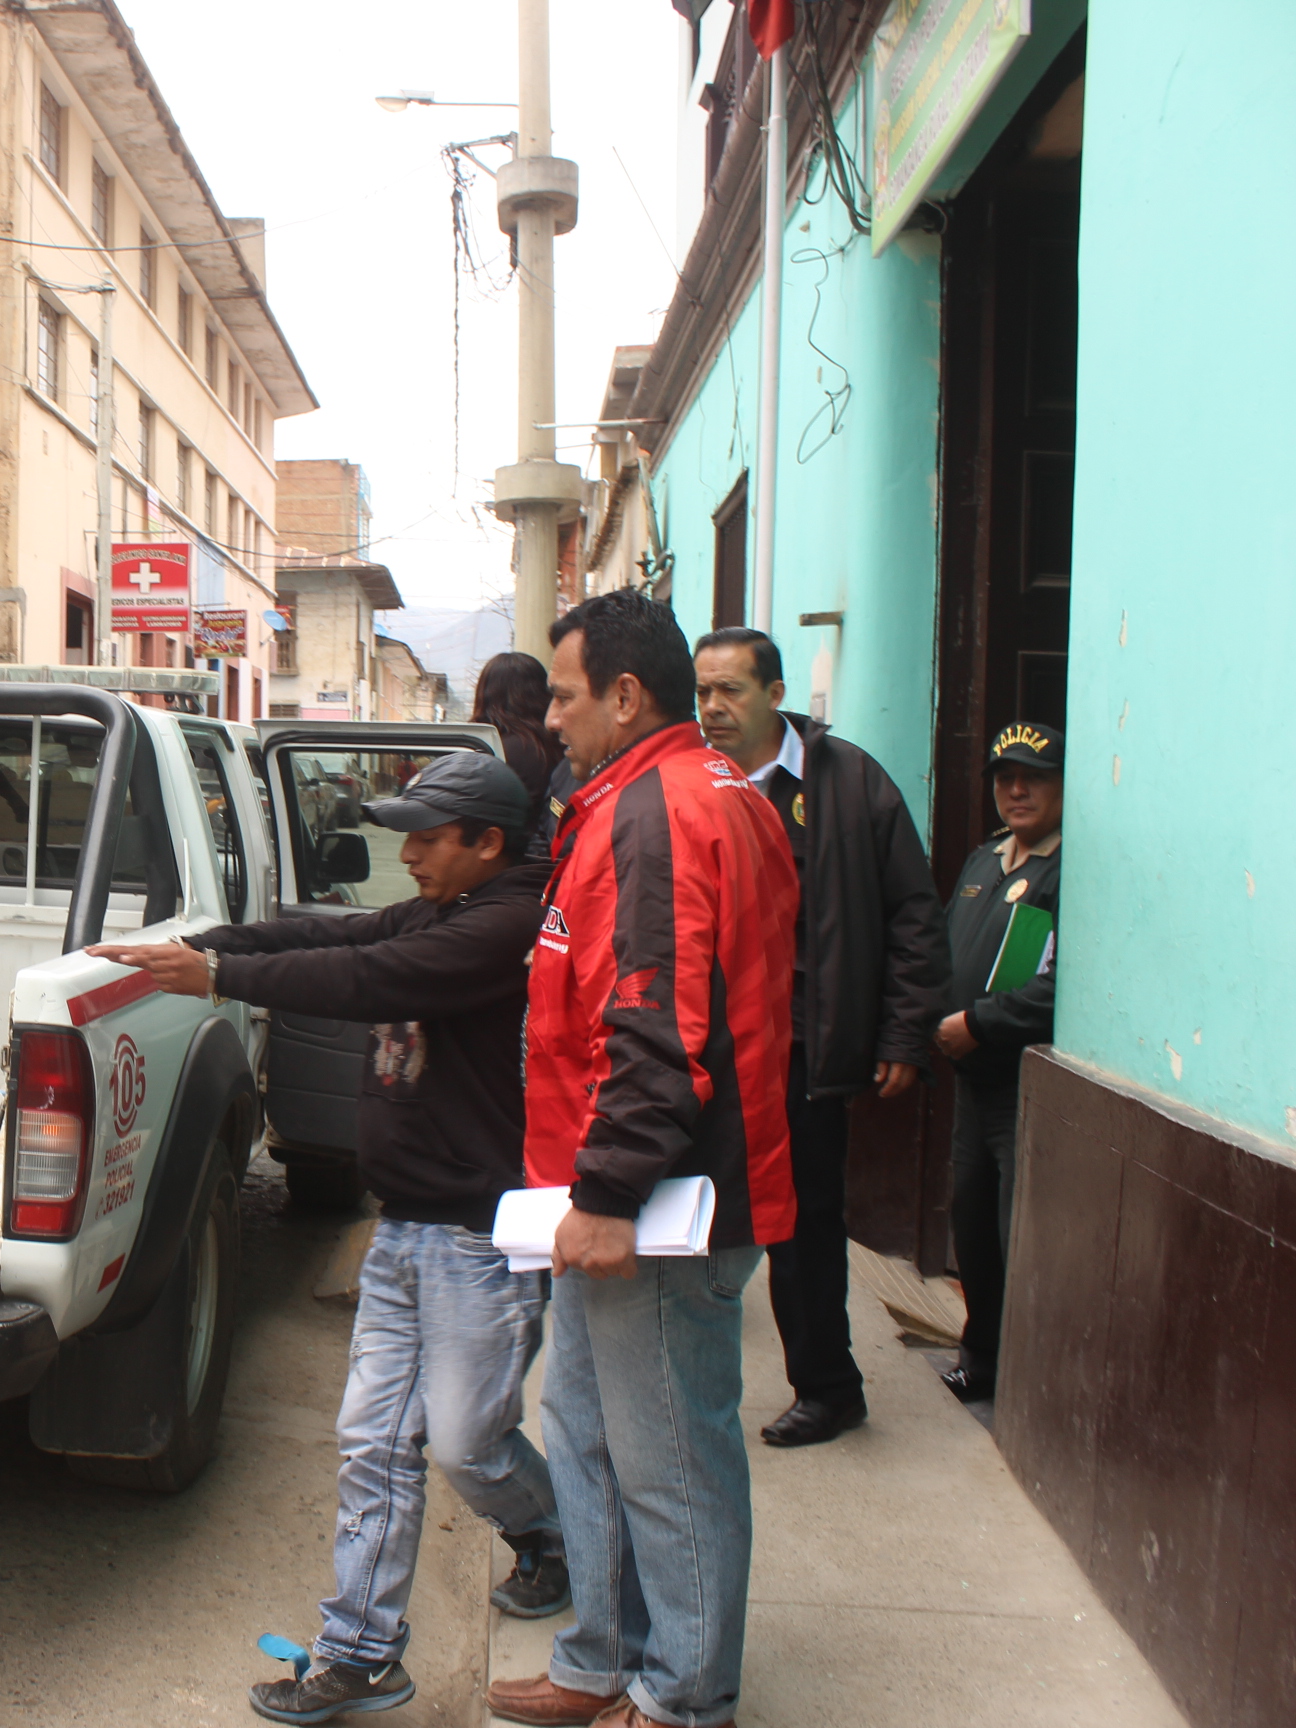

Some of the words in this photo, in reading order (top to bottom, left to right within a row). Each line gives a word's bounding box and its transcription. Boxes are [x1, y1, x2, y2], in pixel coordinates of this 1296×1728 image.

[111, 598, 134, 606] EDICOS
[136, 597, 184, 606] ESPECIALISTAS
[993, 724, 1049, 757] POLICIA
[583, 782, 613, 807] HONDA
[613, 998, 661, 1010] HONDA
[109, 1055, 146, 1117] 105
[104, 1133, 141, 1167] EMERGENCIA
[105, 1160, 133, 1190] POLICIAL
